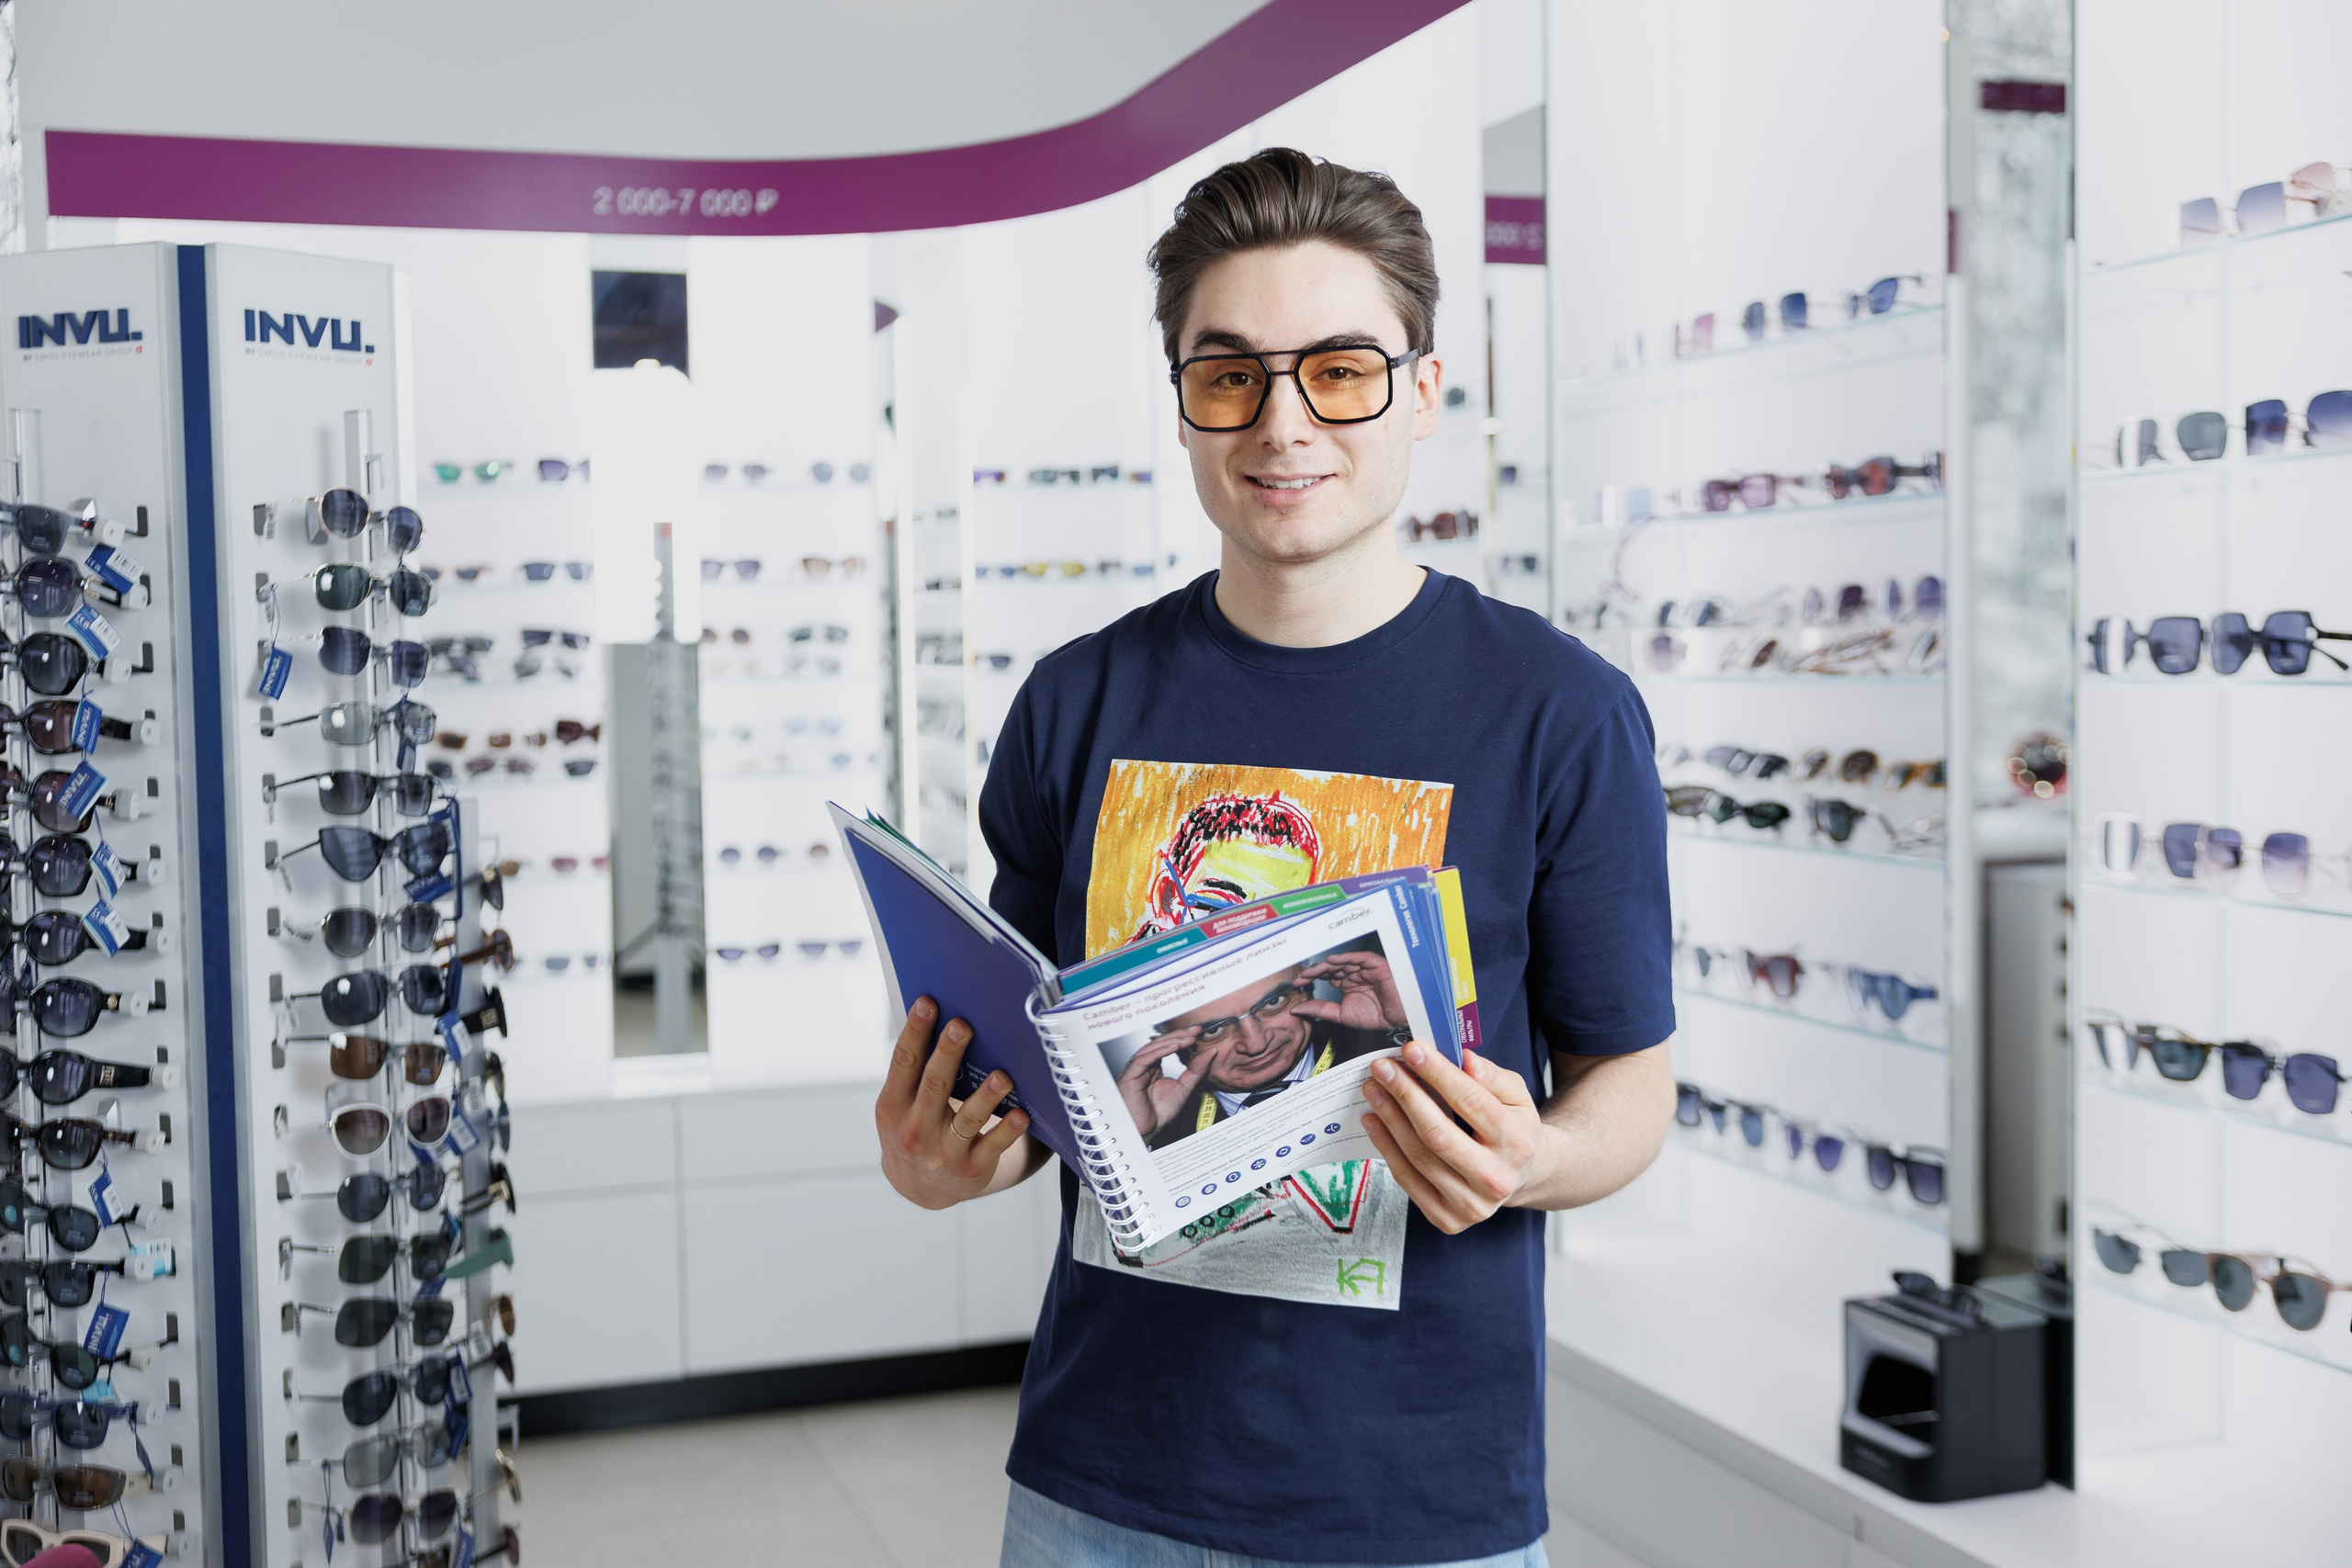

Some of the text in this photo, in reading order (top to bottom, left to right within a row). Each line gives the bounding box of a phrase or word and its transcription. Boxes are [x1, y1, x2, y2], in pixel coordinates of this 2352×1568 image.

[593, 186, 614, 216] 2
[700, 188, 752, 218] 000
[1329, 908, 1371, 930] camber
[1082, 1002, 1131, 1021] Camber
[1145, 958, 1243, 1002] прогрессивные
[1246, 937, 1287, 960] линзы
[1088, 984, 1205, 1030] нового поколения
